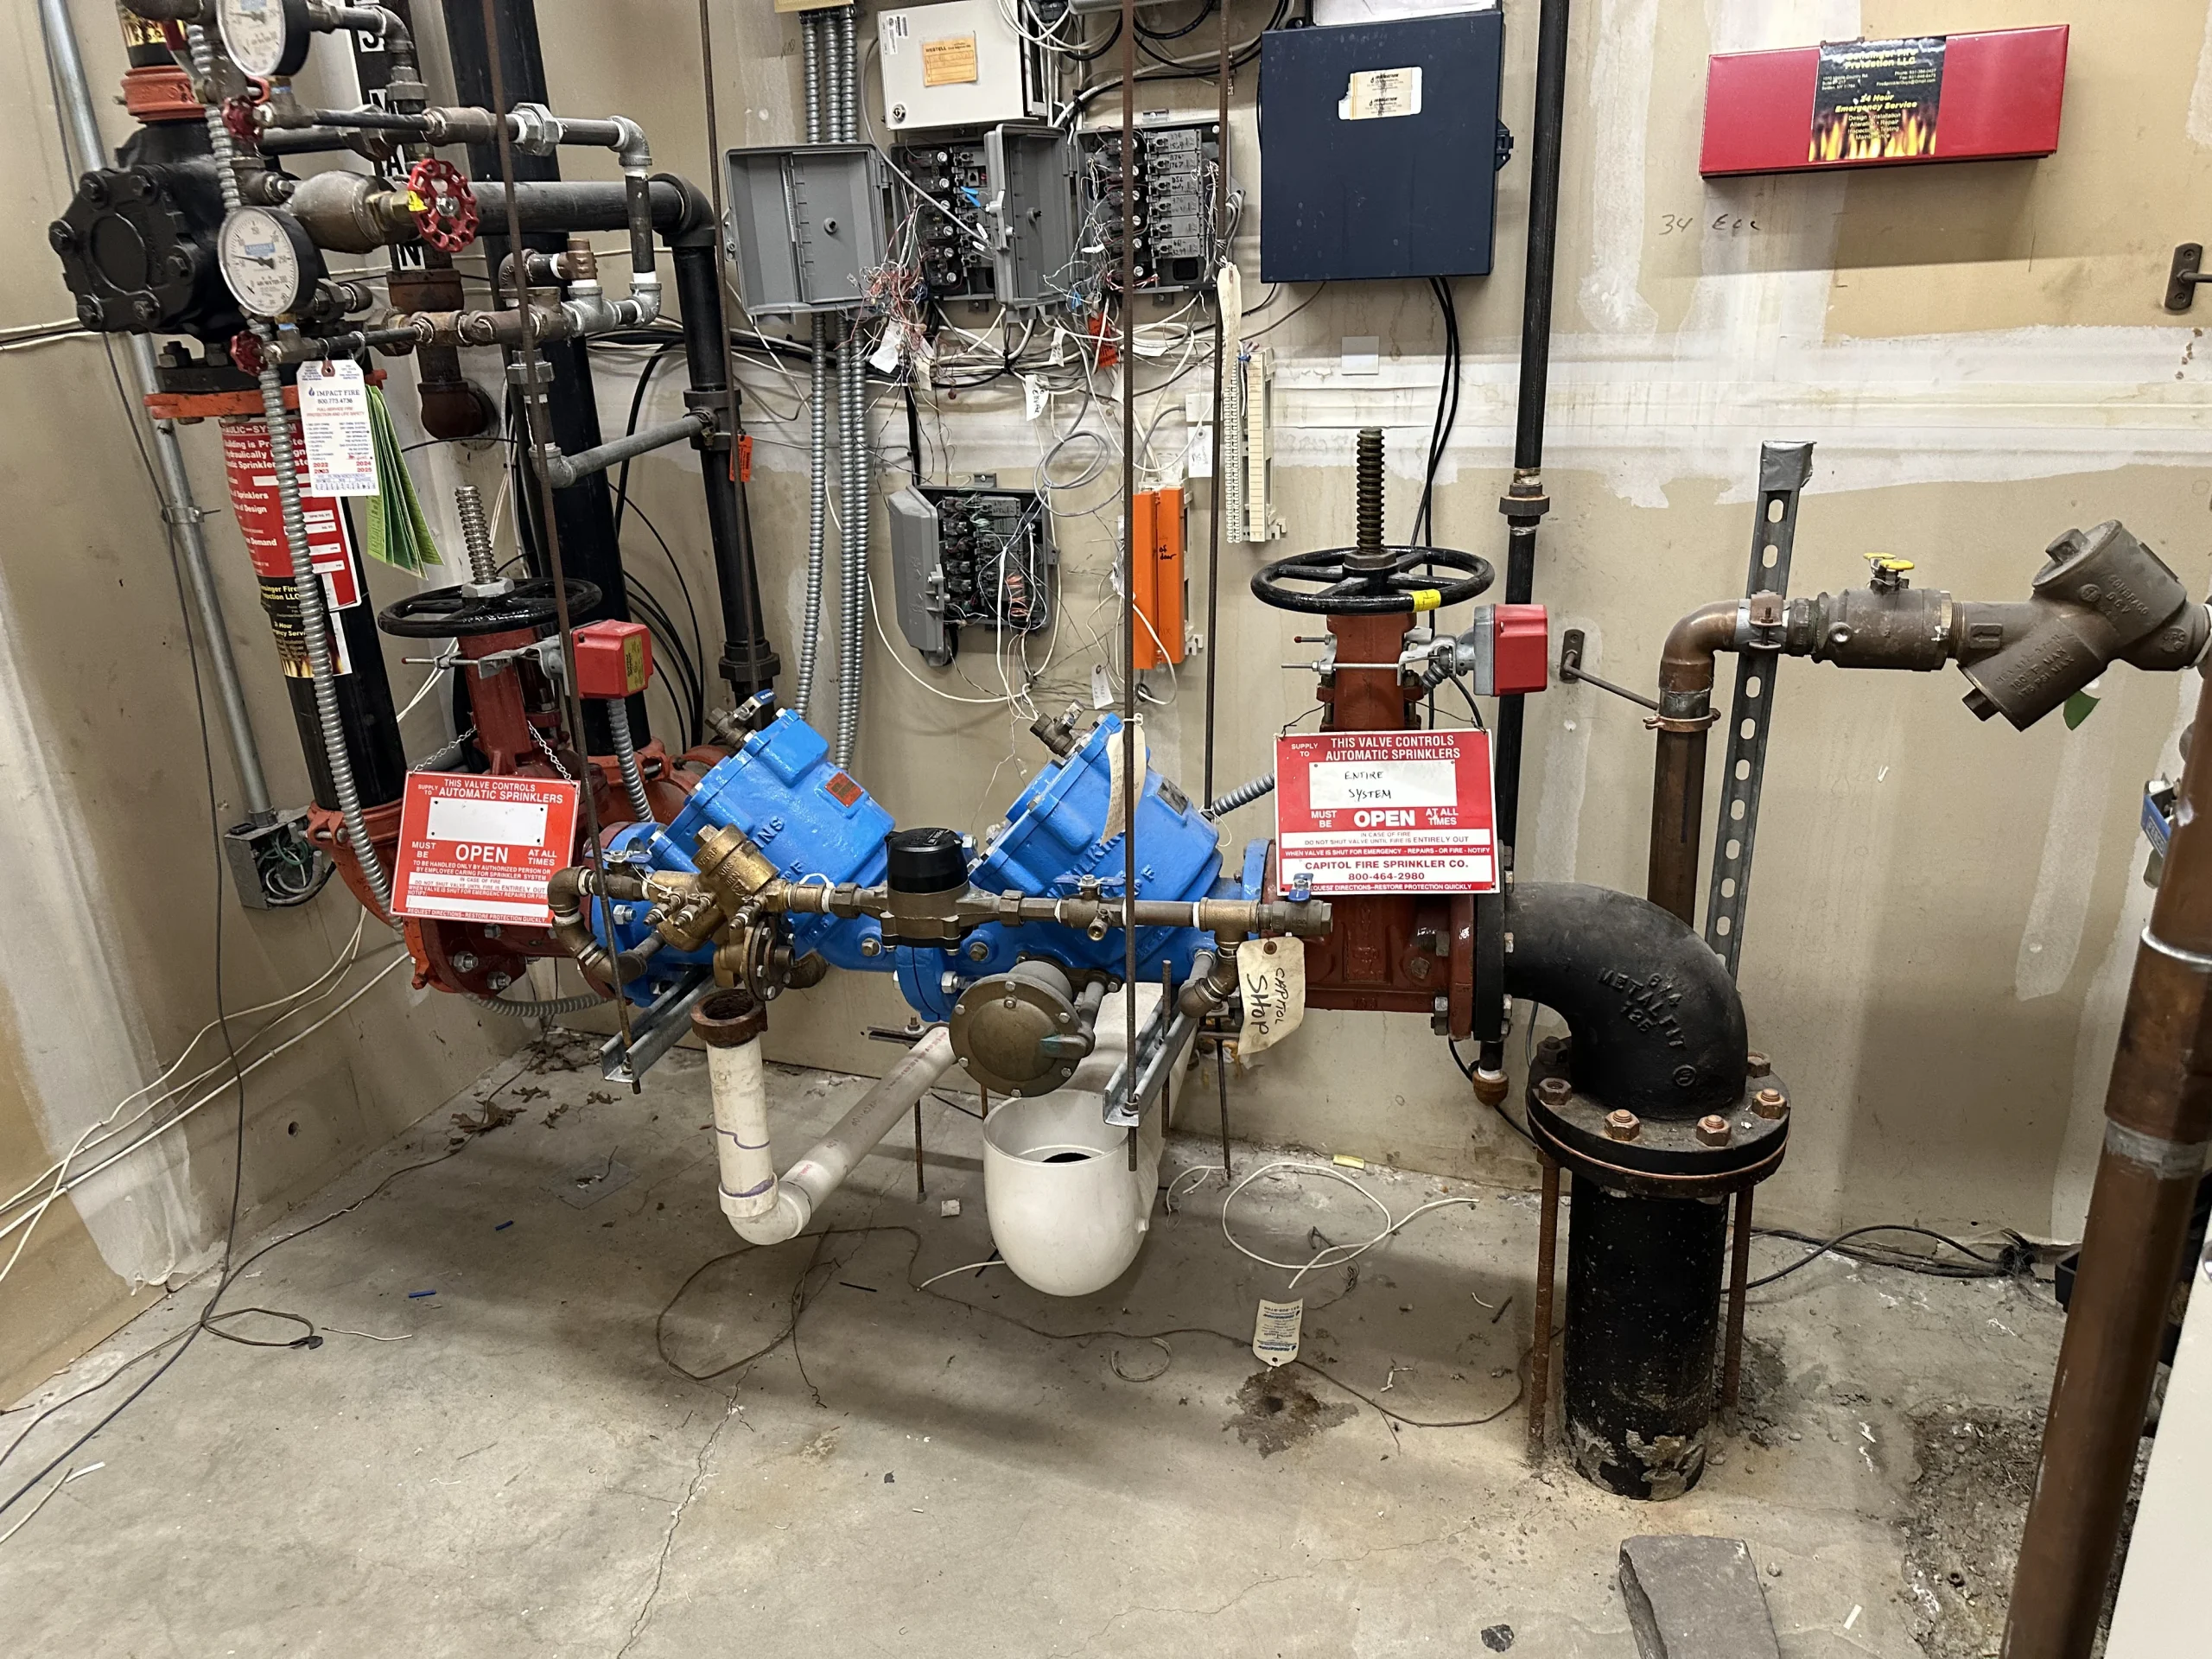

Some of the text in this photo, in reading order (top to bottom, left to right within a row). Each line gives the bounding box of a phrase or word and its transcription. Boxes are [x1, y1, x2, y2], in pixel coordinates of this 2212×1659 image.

[1835, 101, 1918, 113] Emergency Service
[1659, 214, 1693, 235] 34
[1331, 735, 1454, 748] THIS VALVE CONTROLS
[1326, 748, 1460, 761] AUTOMATIC SPRINKLERS
[1344, 771, 1384, 780] ENTIRE
[444, 779, 536, 792] THIS VALVE CONTROLS
[439, 787, 563, 804] AUTOMATIC SPRINKLERS
[1348, 789, 1392, 802] SYSTEM
[1311, 810, 1337, 819] MUST
[1353, 810, 1415, 827] OPEN
[1428, 817, 1457, 826] TIMES
[412, 841, 437, 850] MUST
[456, 844, 508, 864] OPEN
[528, 857, 555, 866] TIMES
